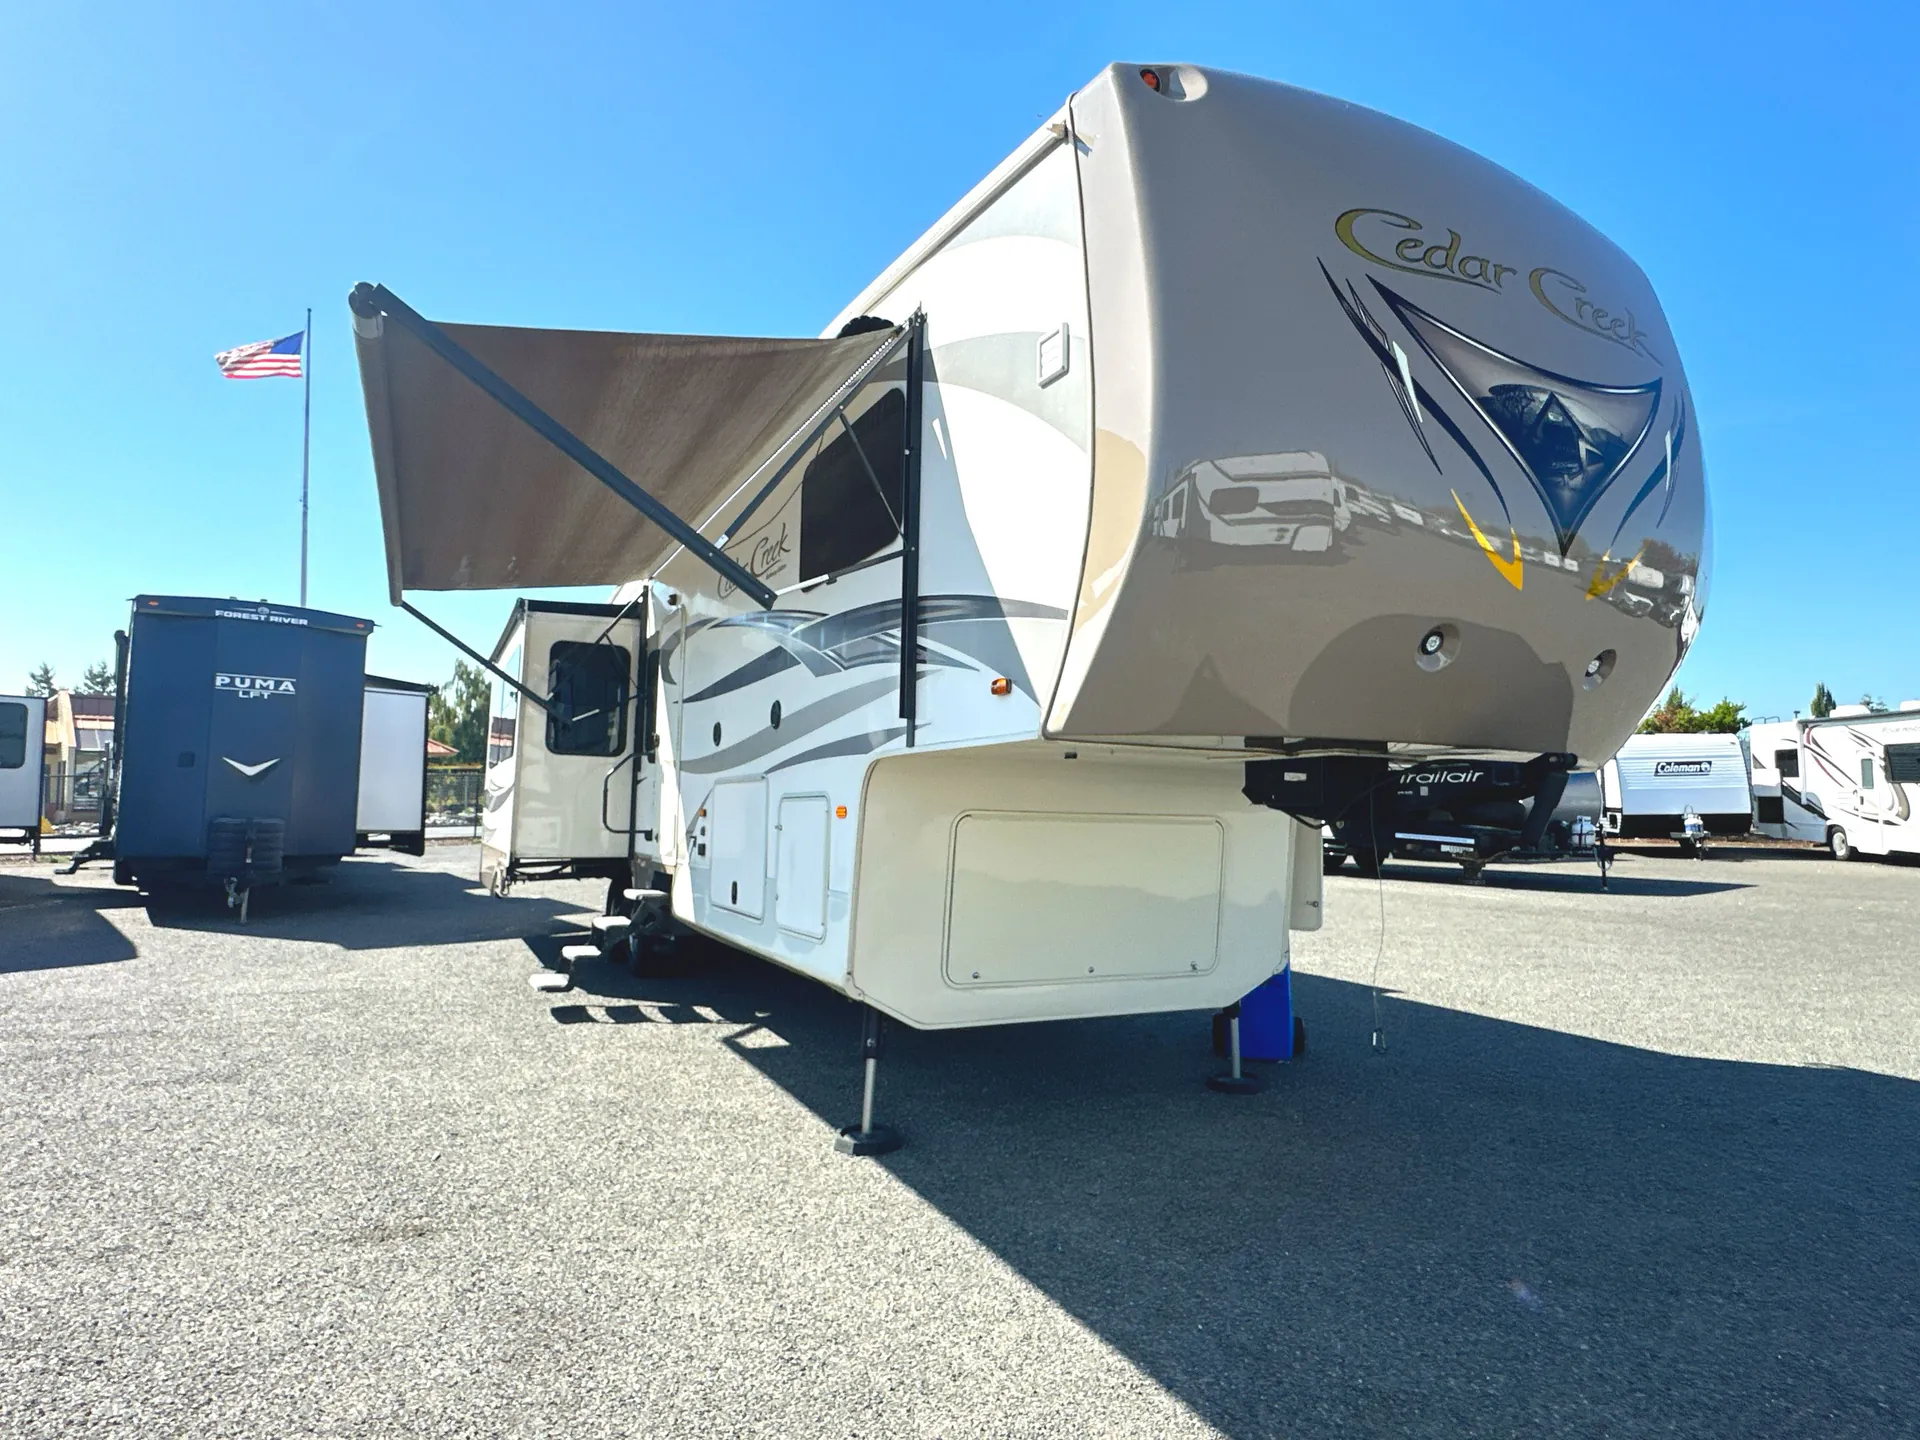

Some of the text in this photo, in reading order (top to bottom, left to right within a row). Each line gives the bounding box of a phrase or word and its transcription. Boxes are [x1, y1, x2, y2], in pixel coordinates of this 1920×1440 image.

[1335, 208, 1662, 367] Cedar Creek
[215, 609, 308, 625] FOREST RIVER
[215, 676, 295, 692] PUMA
[1657, 762, 1701, 773] Coleman
